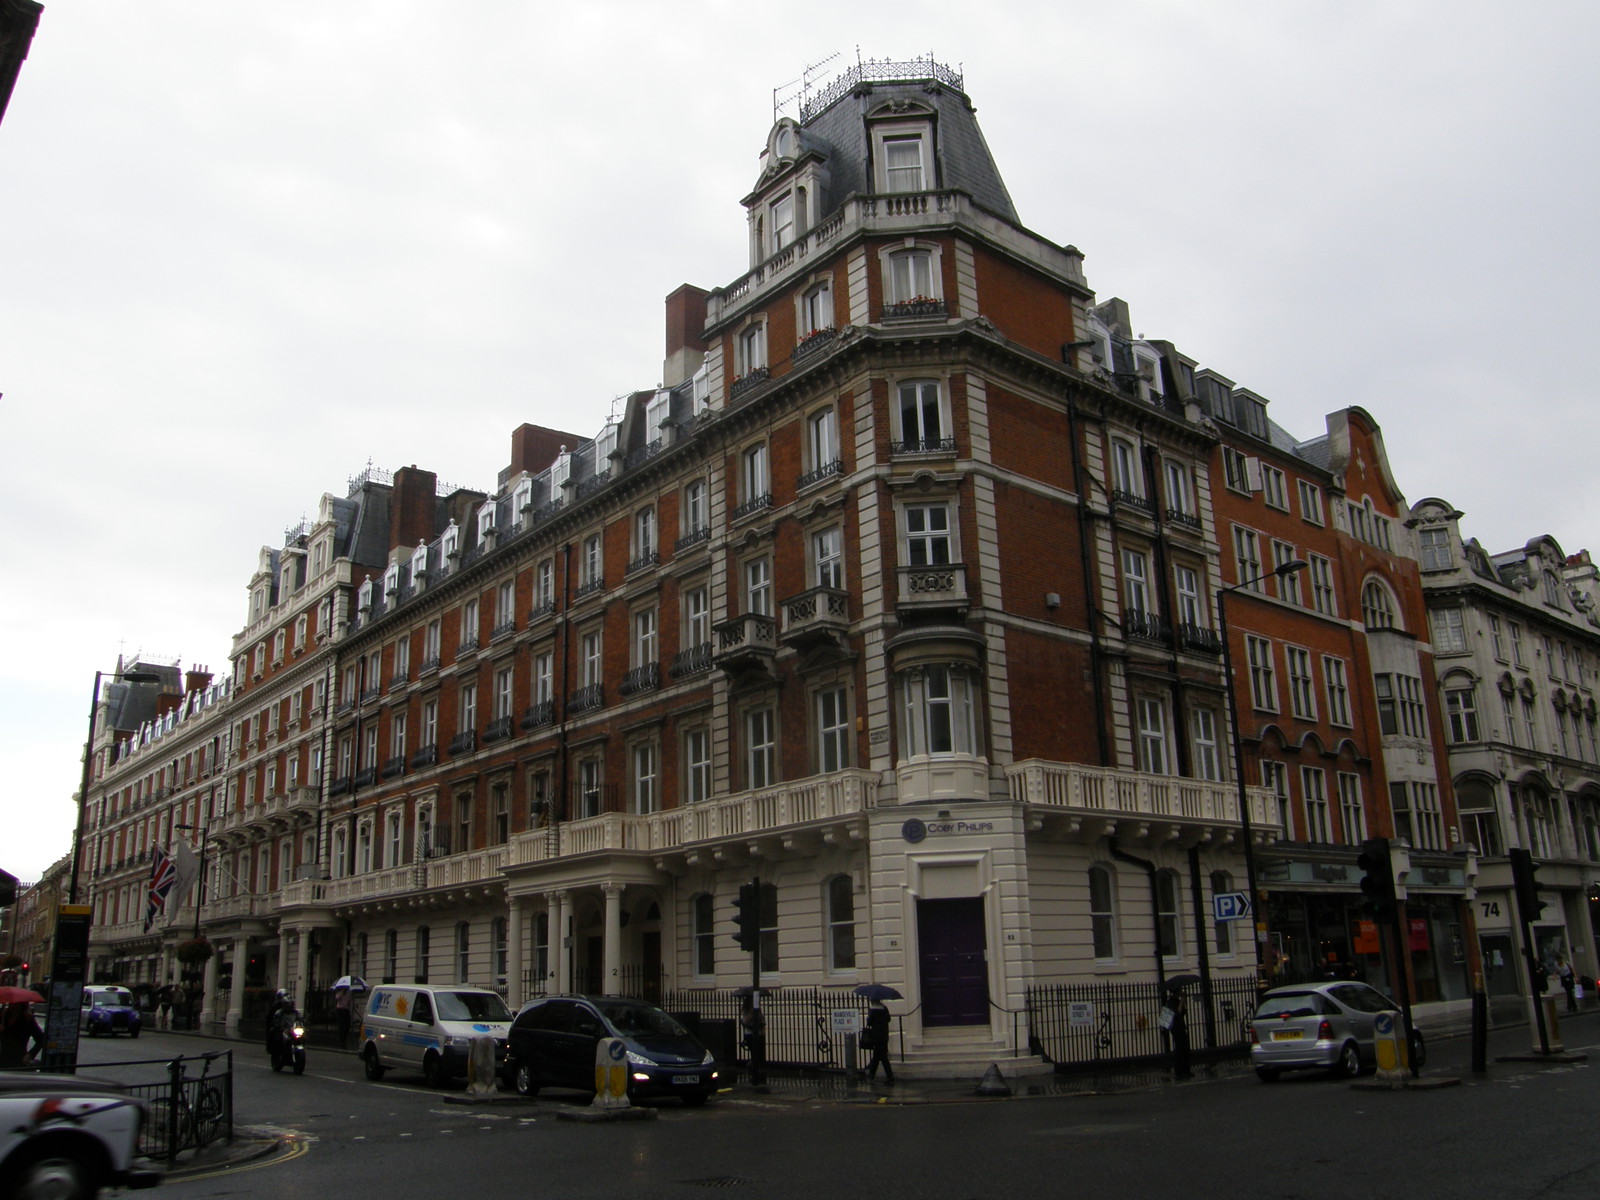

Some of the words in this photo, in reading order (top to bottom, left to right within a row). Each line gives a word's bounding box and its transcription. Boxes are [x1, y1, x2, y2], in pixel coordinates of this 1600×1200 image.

[957, 821, 993, 832] PHILIPS
[1219, 897, 1232, 916] P
[1481, 902, 1500, 918] 74
[612, 968, 618, 976] 2
